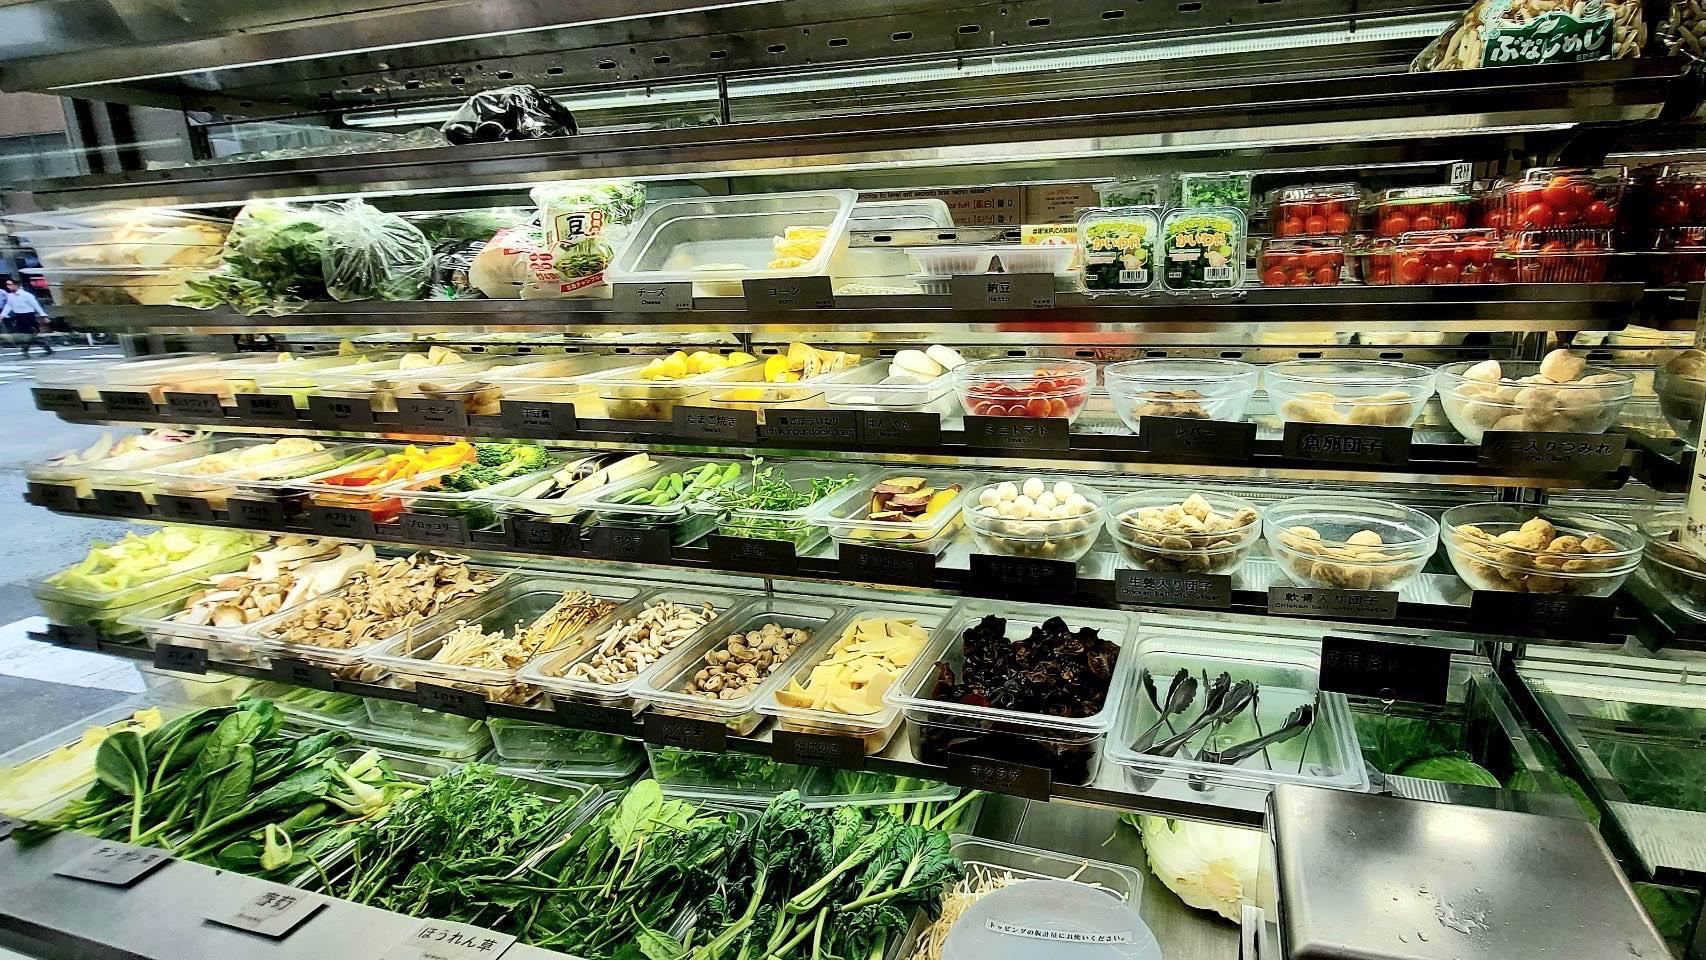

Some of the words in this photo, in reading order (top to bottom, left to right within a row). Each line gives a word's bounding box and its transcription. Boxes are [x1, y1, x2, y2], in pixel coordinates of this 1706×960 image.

[1489, 25, 1608, 64] ぶなしめじ
[638, 287, 665, 298] チーズ
[768, 287, 800, 296] コーン
[987, 282, 1011, 293] 納豆
[687, 414, 737, 426] たまご焼き
[866, 417, 912, 430] はんぺん
[984, 423, 1049, 436] ミニトマト
[409, 519, 459, 531] ブロッコリー
[613, 534, 641, 545] オクラ
[1129, 577, 1214, 592] 生姜入り団子
[1285, 592, 1379, 606] 軟骨入り団子
[793, 740, 839, 754] たけのこ
[417, 927, 498, 953] ほうれん草
